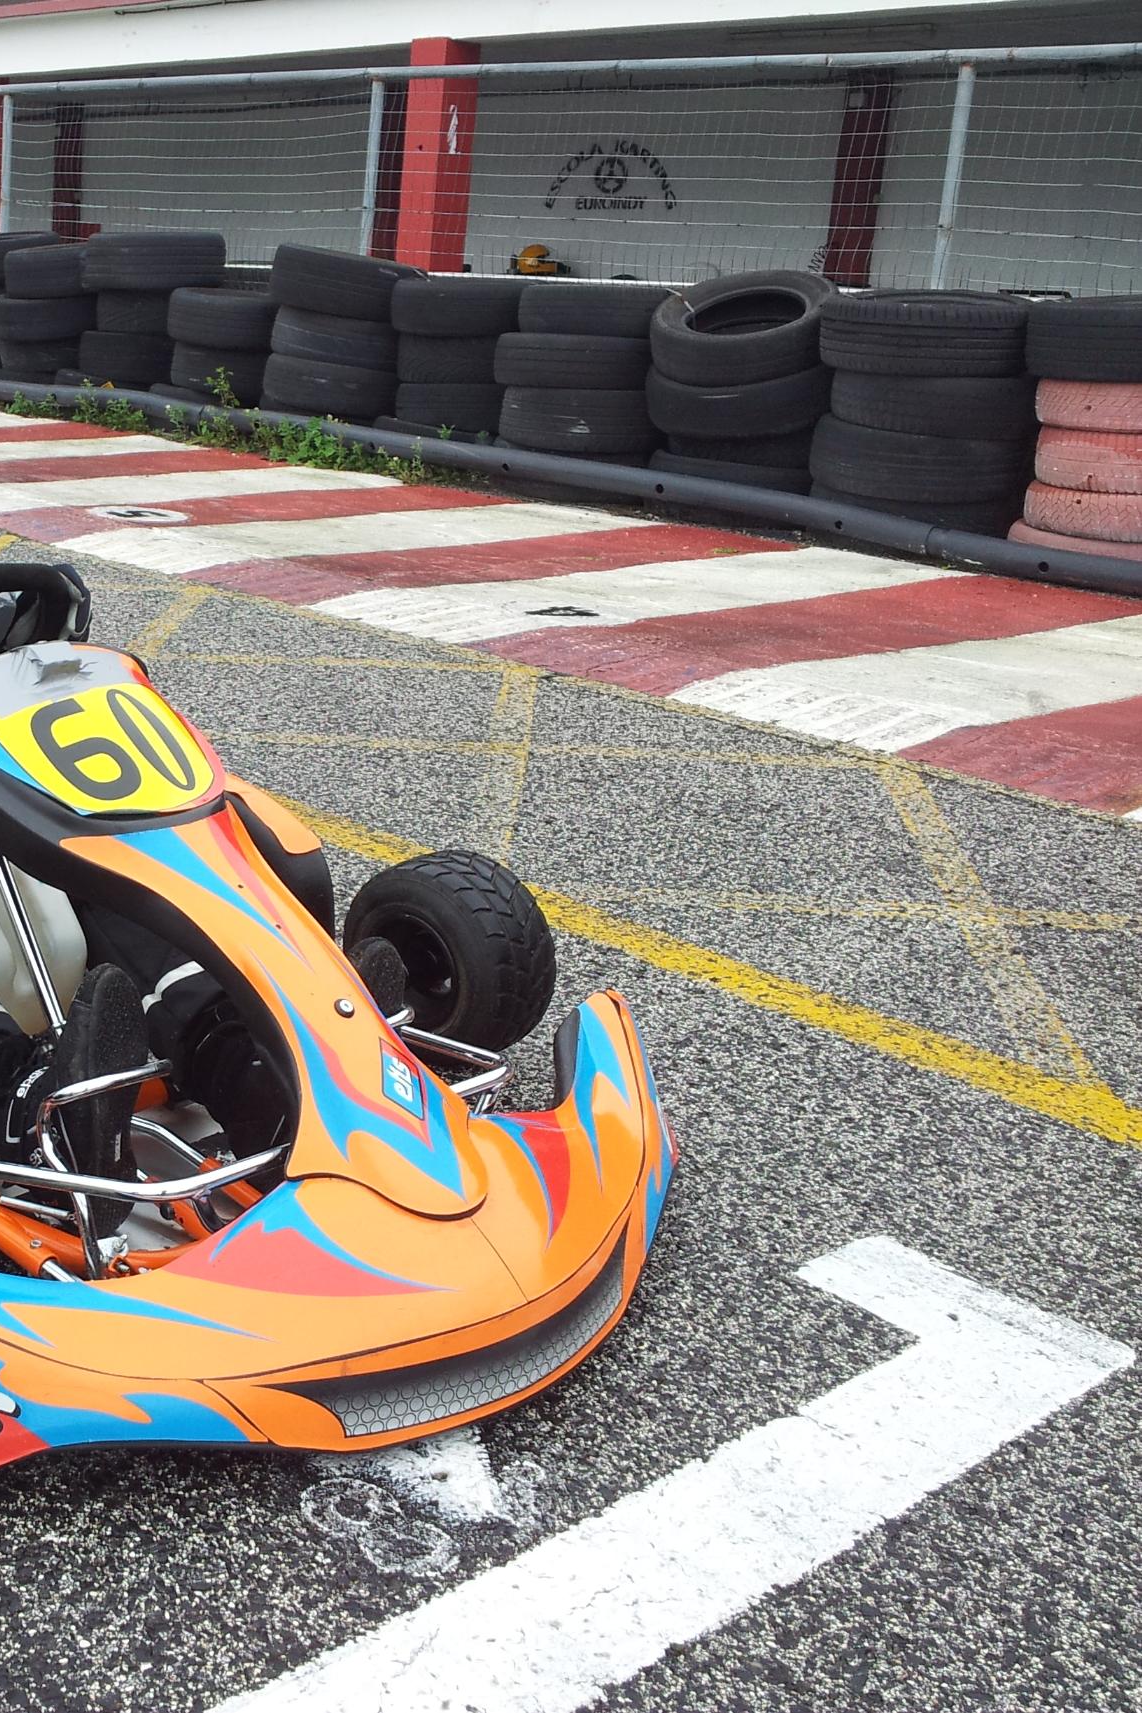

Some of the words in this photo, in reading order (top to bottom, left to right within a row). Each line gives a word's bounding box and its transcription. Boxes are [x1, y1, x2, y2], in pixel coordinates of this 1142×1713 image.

[544, 143, 604, 209] ESCOLA
[575, 196, 647, 210] EUROINDY
[30, 689, 196, 801] 60
